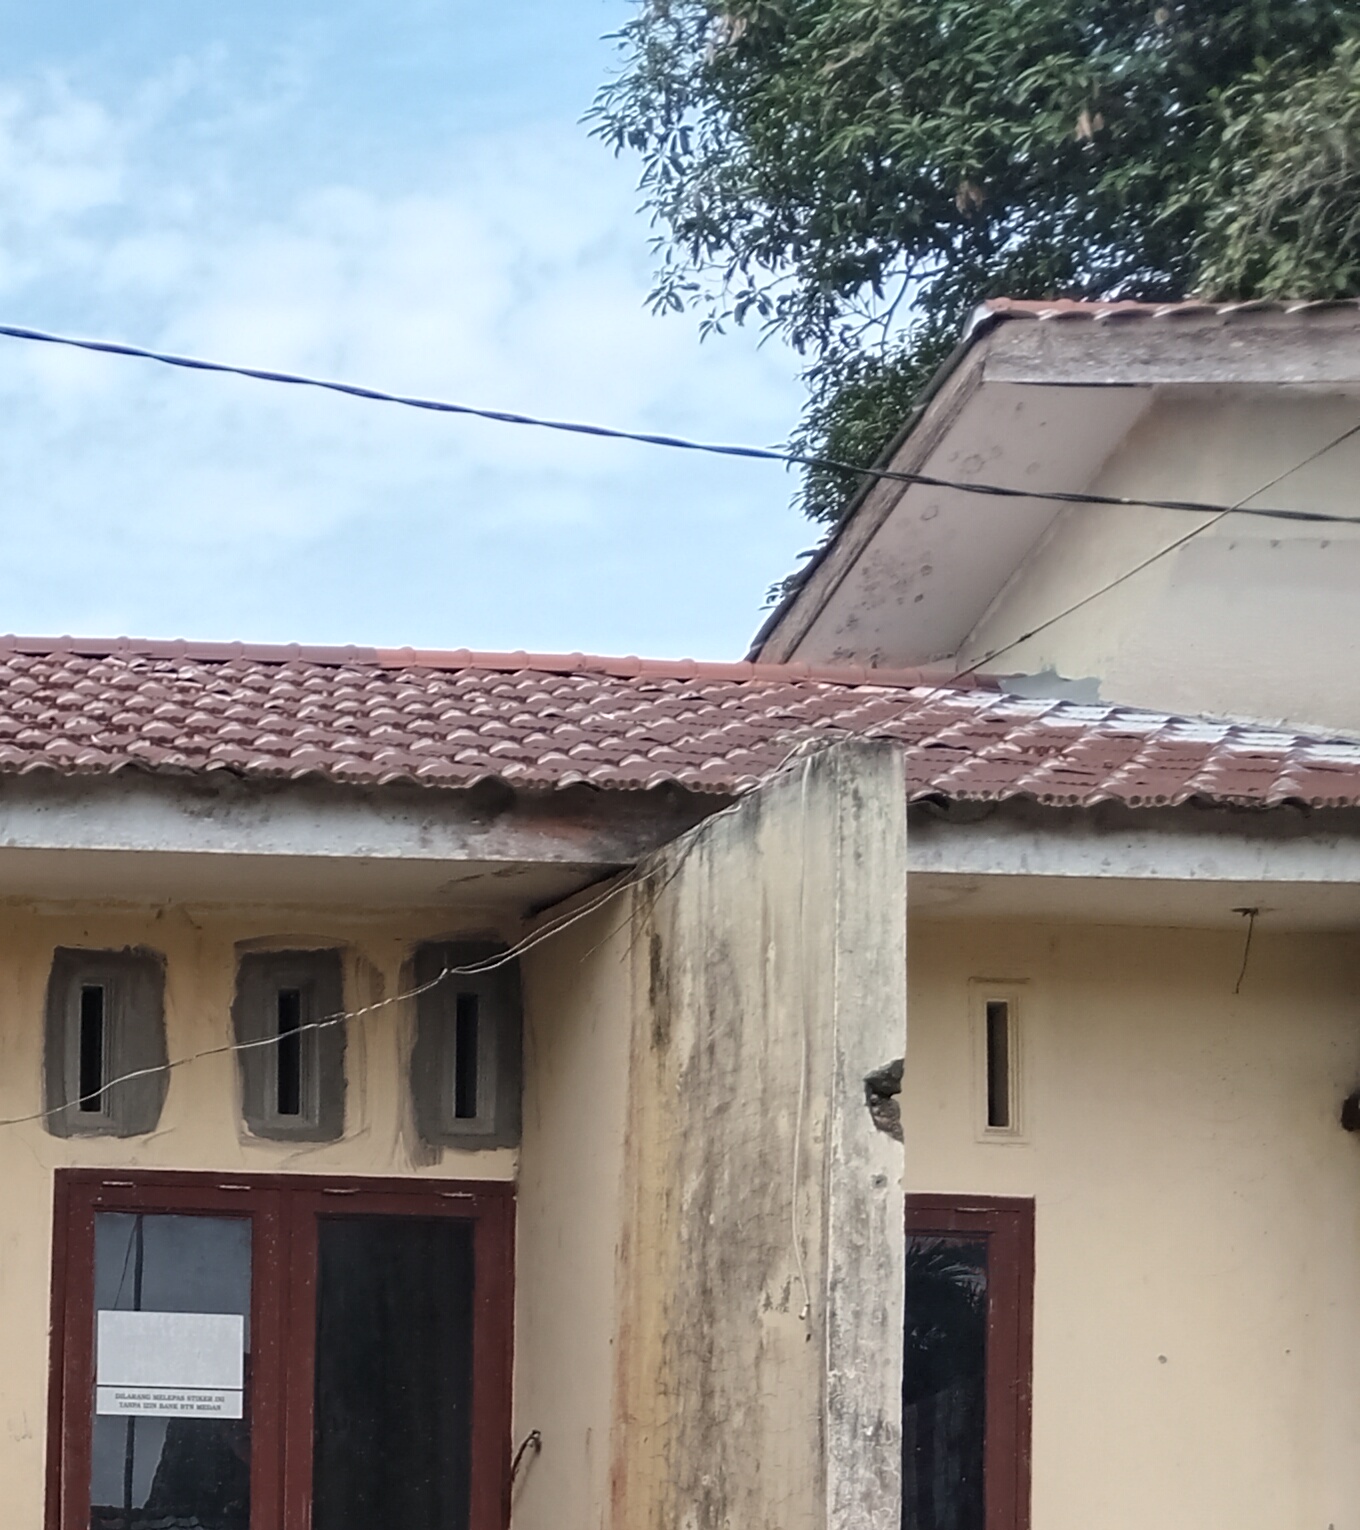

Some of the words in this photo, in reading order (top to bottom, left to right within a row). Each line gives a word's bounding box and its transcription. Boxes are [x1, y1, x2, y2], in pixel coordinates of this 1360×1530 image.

[115, 1393, 151, 1401] DILARANG
[187, 1395, 213, 1403] STIKER
[119, 1401, 141, 1409] TANPA
[159, 1402, 179, 1410] BANK
